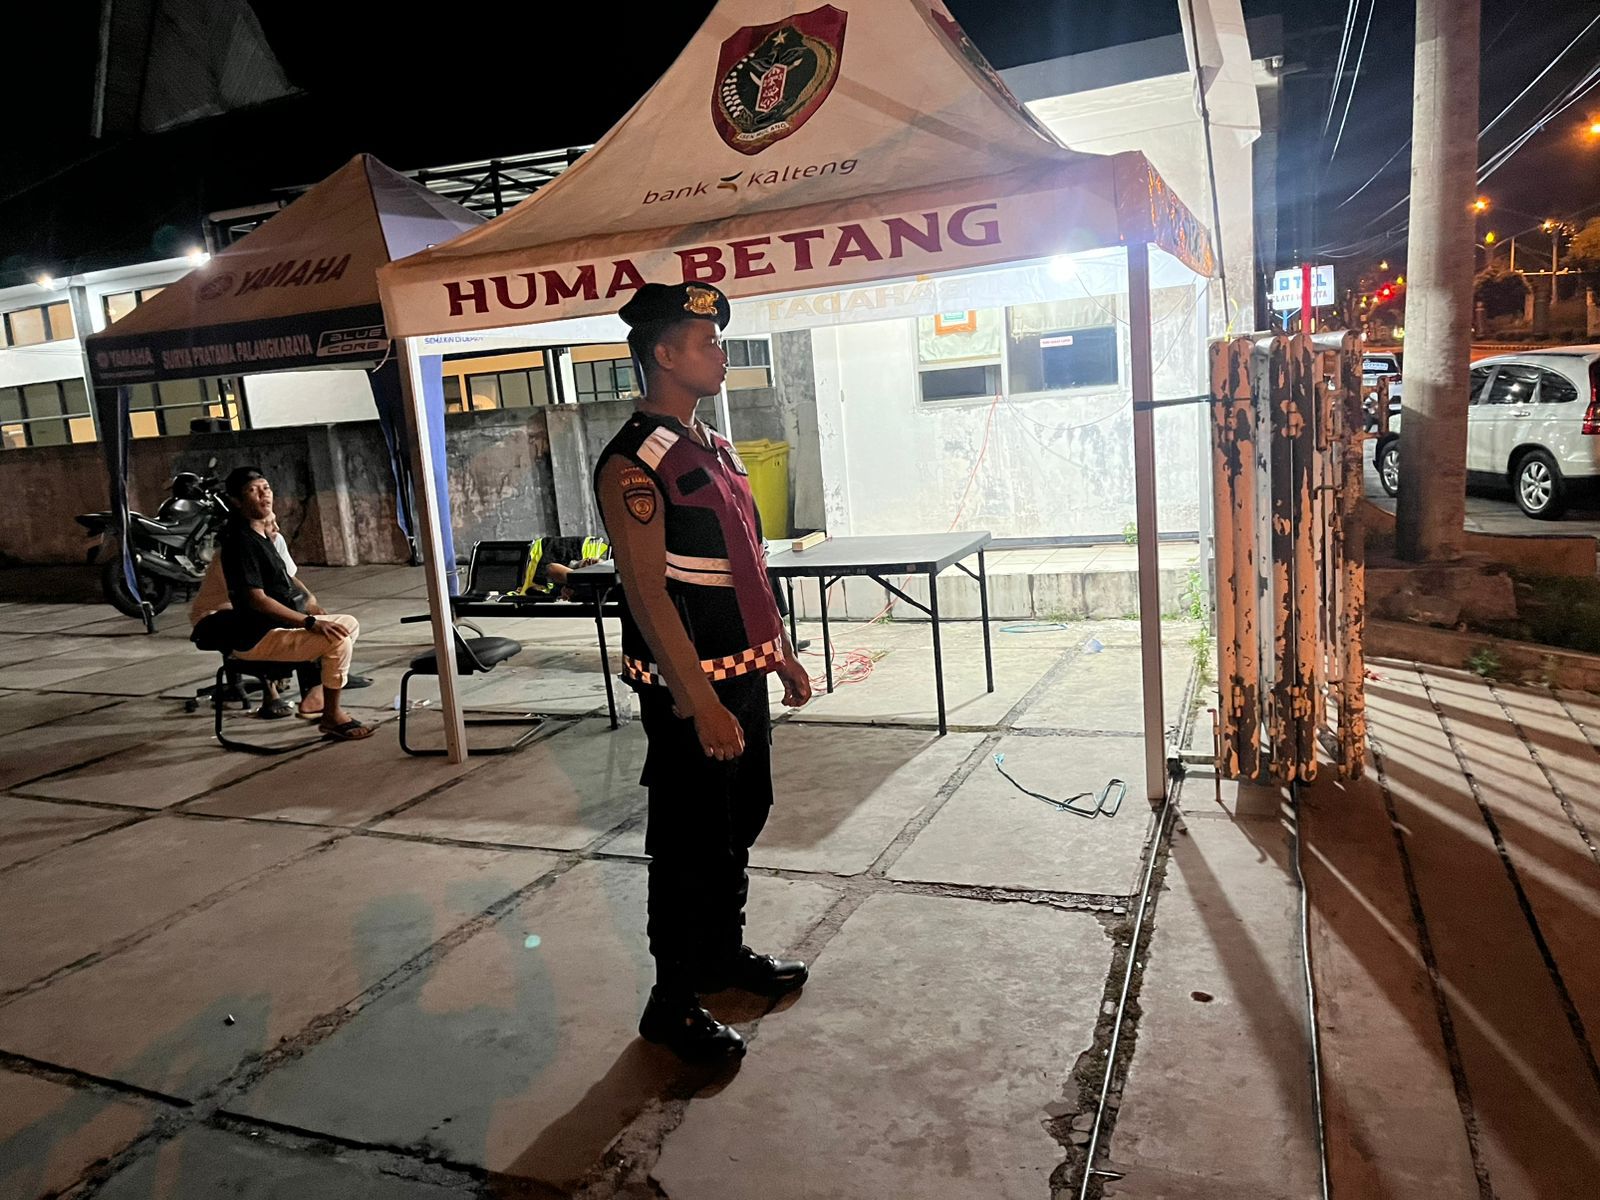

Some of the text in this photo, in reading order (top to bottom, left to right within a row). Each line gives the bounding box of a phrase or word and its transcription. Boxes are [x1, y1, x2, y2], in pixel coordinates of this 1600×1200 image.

[642, 159, 858, 205] bank kalteng
[235, 254, 352, 297] YAMAHA
[444, 259, 647, 316] HUMA
[674, 202, 1003, 285] BETANG
[162, 348, 193, 370] SURYA
[192, 343, 236, 366] PRATAMA
[236, 334, 313, 362] PALANGKARAYA
[327, 340, 379, 353] CORE
[330, 328, 383, 341] BLUE
